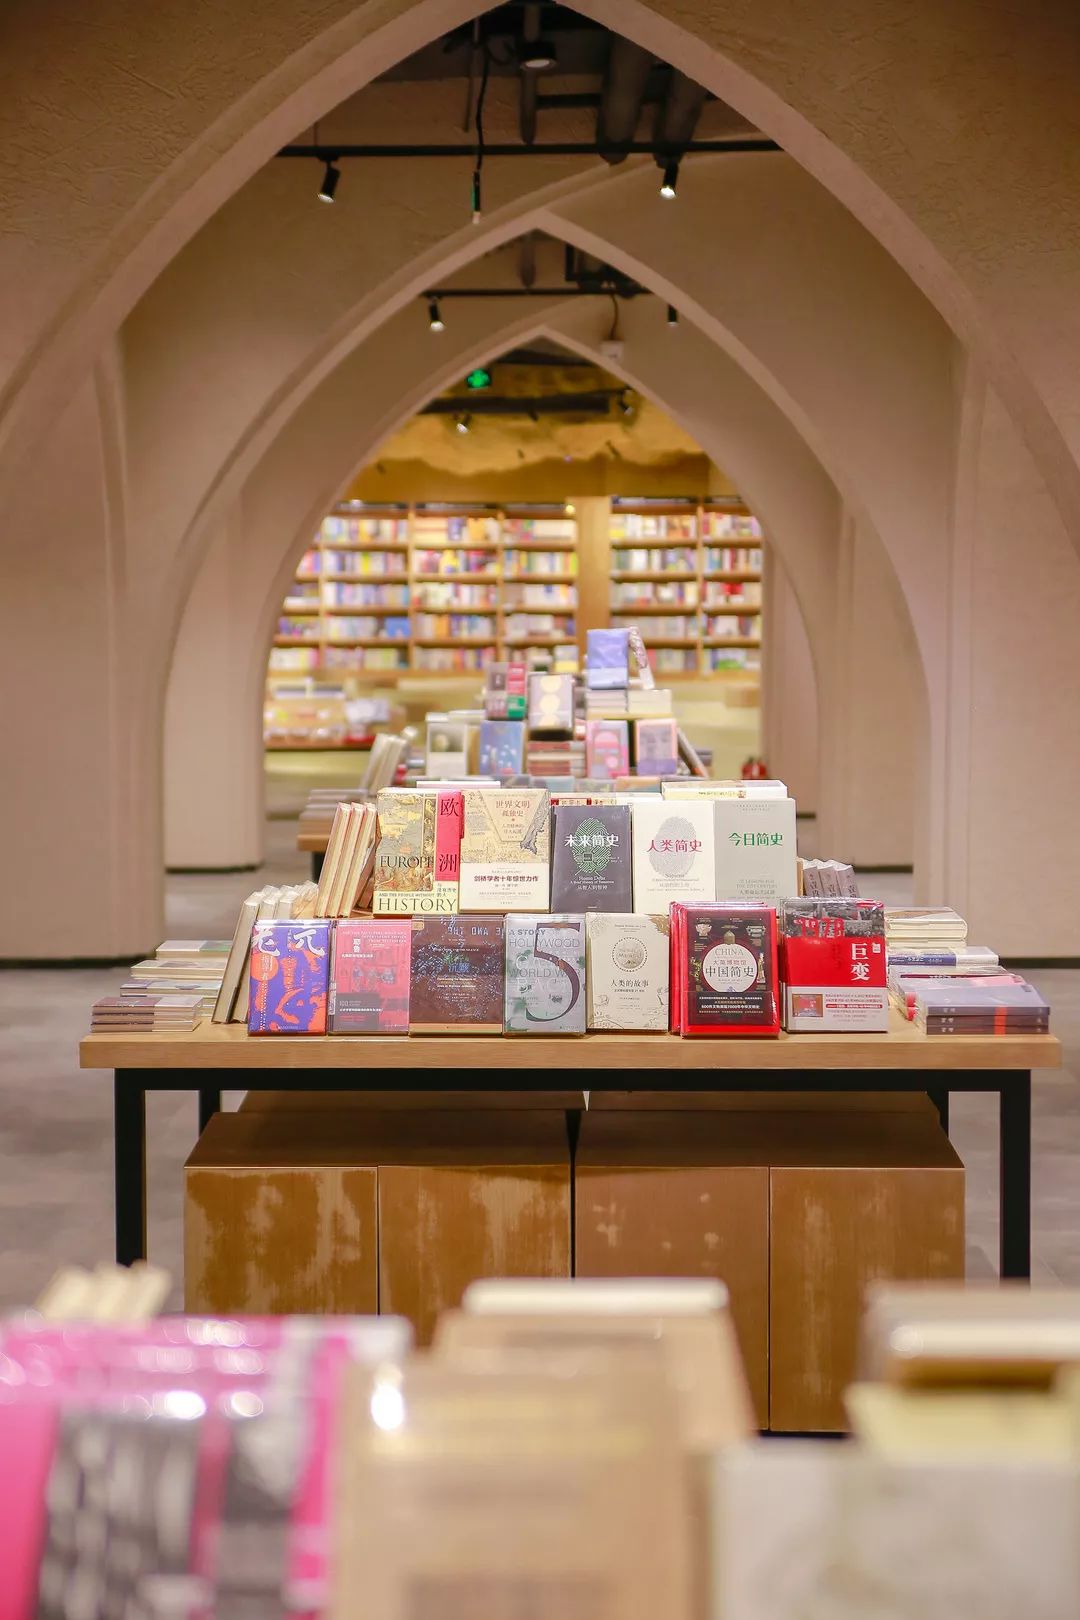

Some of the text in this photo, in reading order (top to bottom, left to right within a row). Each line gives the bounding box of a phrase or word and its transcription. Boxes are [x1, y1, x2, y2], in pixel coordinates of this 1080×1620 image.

[495, 800, 530, 809] 世界文明
[564, 834, 620, 848] 未来简史
[646, 839, 703, 853] 人类简史
[728, 832, 784, 847] 今日简史
[378, 898, 457, 912] HISTORY
[714, 947, 745, 956] CHINA
[850, 942, 871, 981] 巨变
[705, 965, 755, 978] 中国简史
[610, 979, 649, 988] 人类的故事
